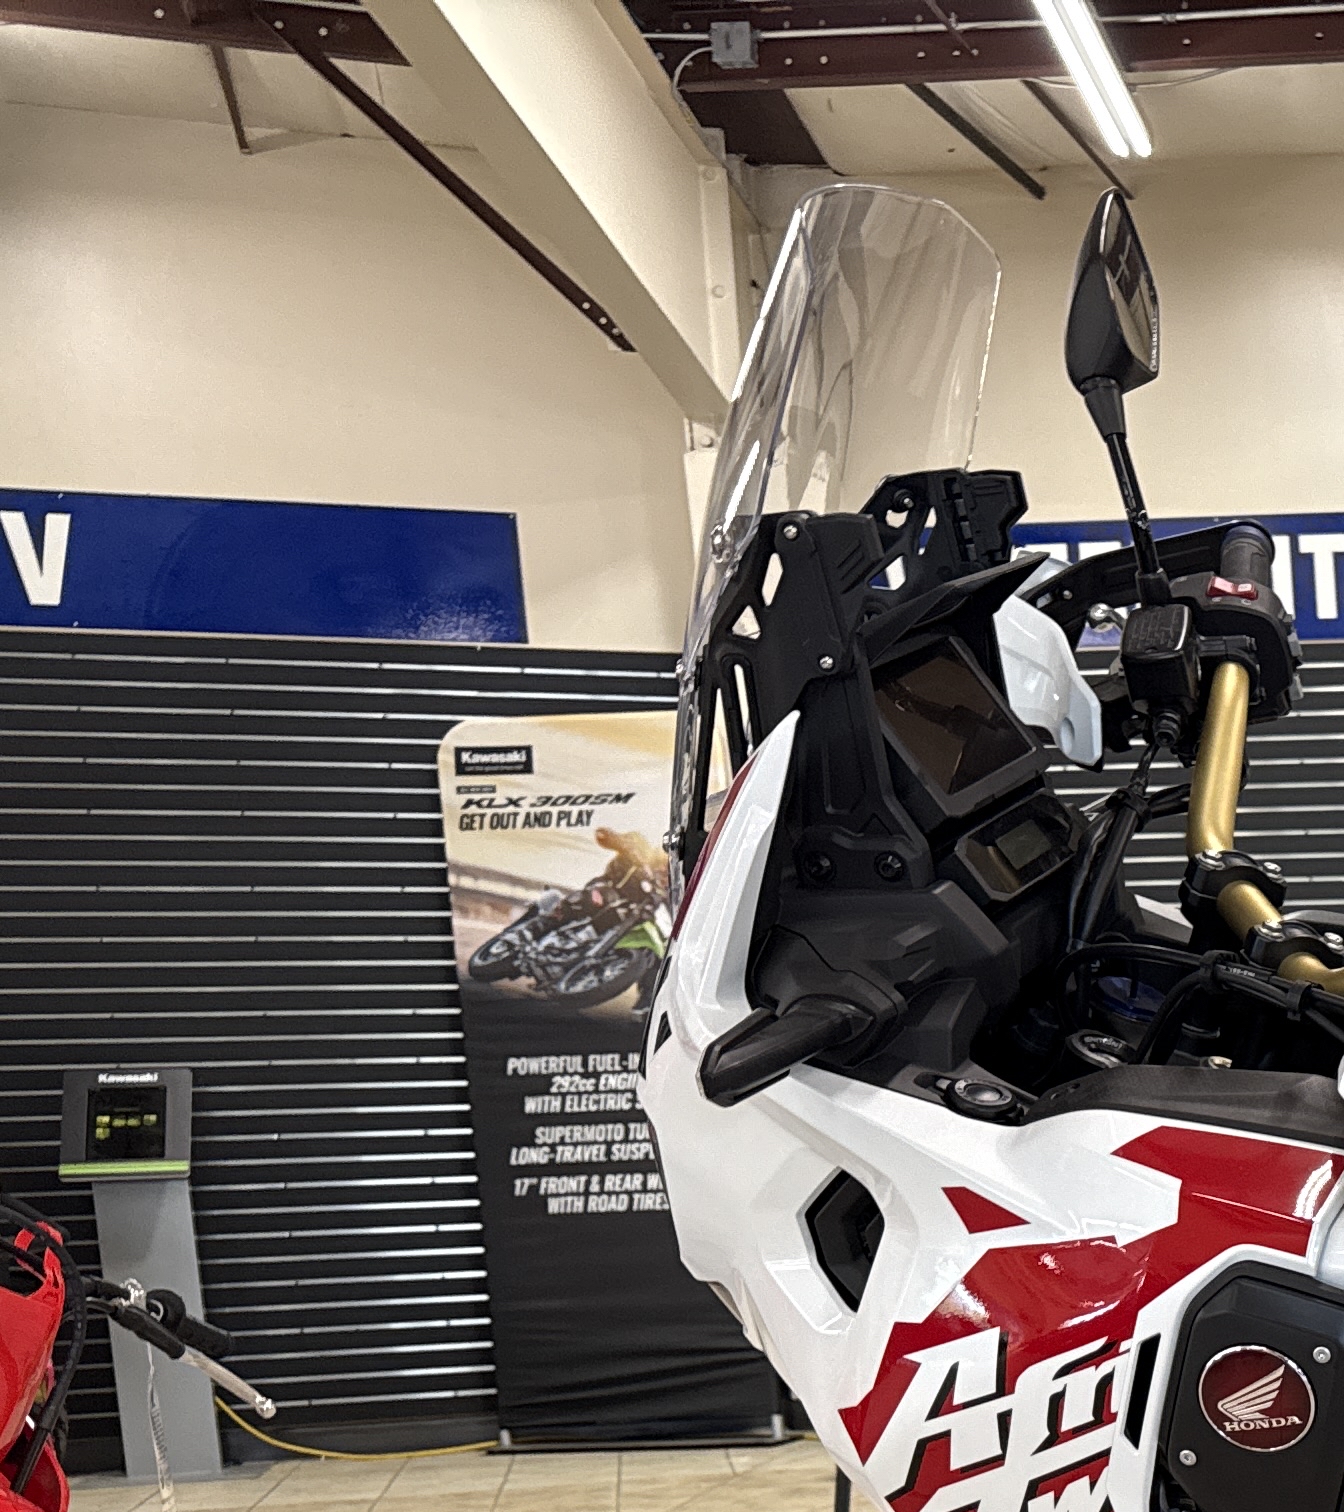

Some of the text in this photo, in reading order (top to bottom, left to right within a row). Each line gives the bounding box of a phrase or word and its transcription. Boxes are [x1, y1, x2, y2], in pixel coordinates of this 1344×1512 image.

[460, 750, 527, 764] Kawasaki
[461, 793, 635, 809] KLX 300SM
[459, 809, 594, 831] GET OUT AND PLAY
[507, 1056, 584, 1076] POWERFUL
[550, 1075, 596, 1093] 292cc
[524, 1096, 561, 1114] WITH
[564, 1093, 633, 1112] ELECTRIC
[534, 1123, 624, 1144] SUPERMOTO
[509, 1143, 607, 1165] LONG-TRAVEL
[539, 1176, 588, 1195] FRONT
[589, 1174, 600, 1193] &
[603, 1173, 643, 1192] REAR
[548, 1196, 583, 1214] WITH
[588, 1195, 629, 1213] ROAD
[1223, 1415, 1303, 1432] HONDA
